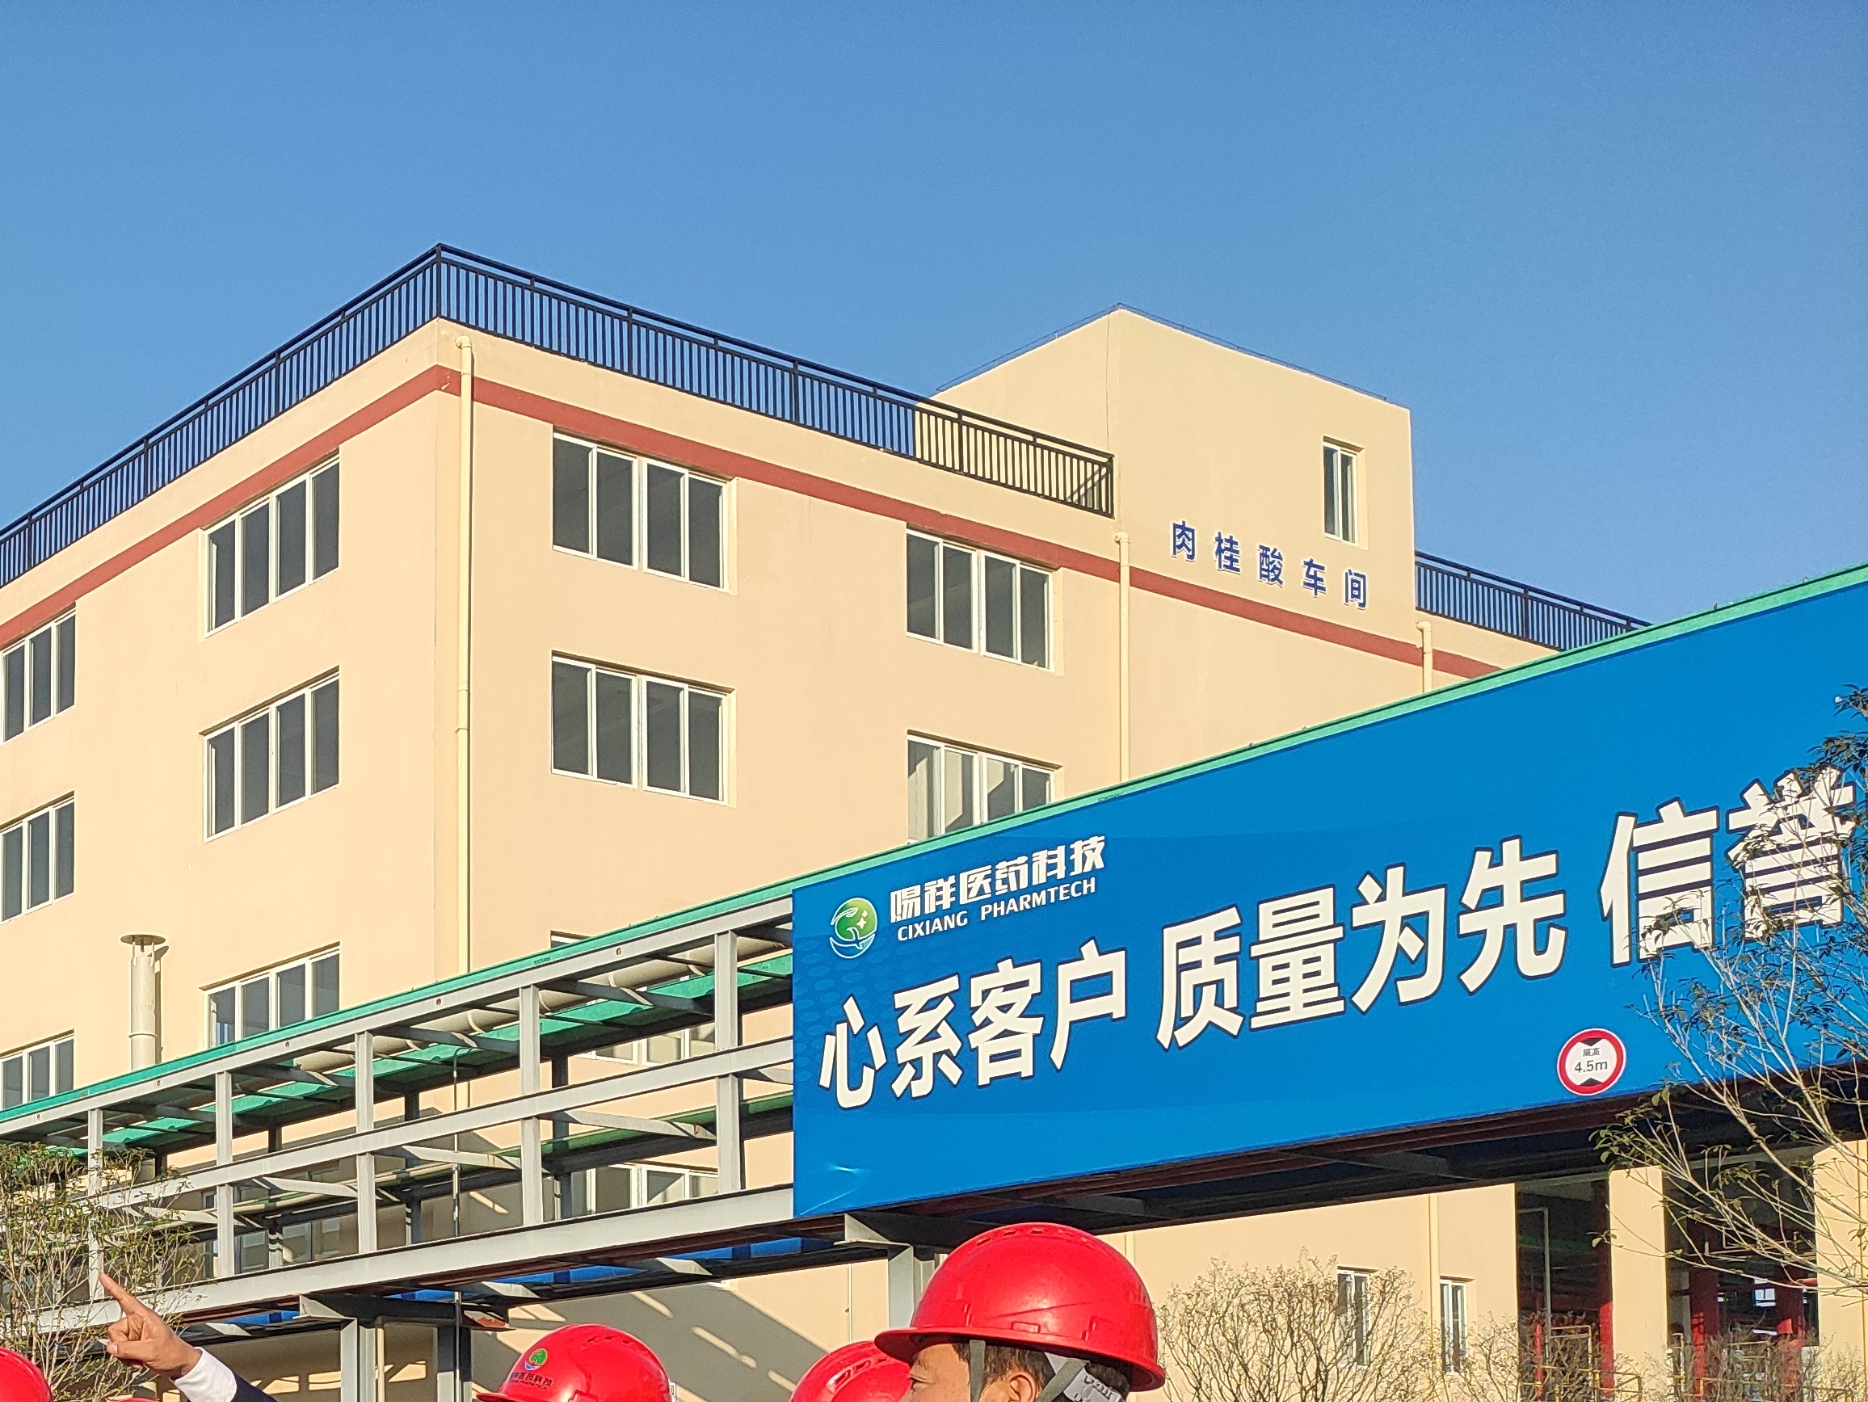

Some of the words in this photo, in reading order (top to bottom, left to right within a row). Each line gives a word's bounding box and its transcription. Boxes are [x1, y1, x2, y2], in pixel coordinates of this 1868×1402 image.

[1171, 520, 1368, 609] 肉桂酸车间
[889, 835, 1106, 923] 赐祥医药科技
[897, 911, 969, 942] CIXIANG
[980, 877, 1097, 919] PHARMTECH
[819, 937, 1127, 1110] 心系客户
[1156, 837, 1567, 1050] 质量为先
[1574, 1060, 1608, 1073] 4.5m
